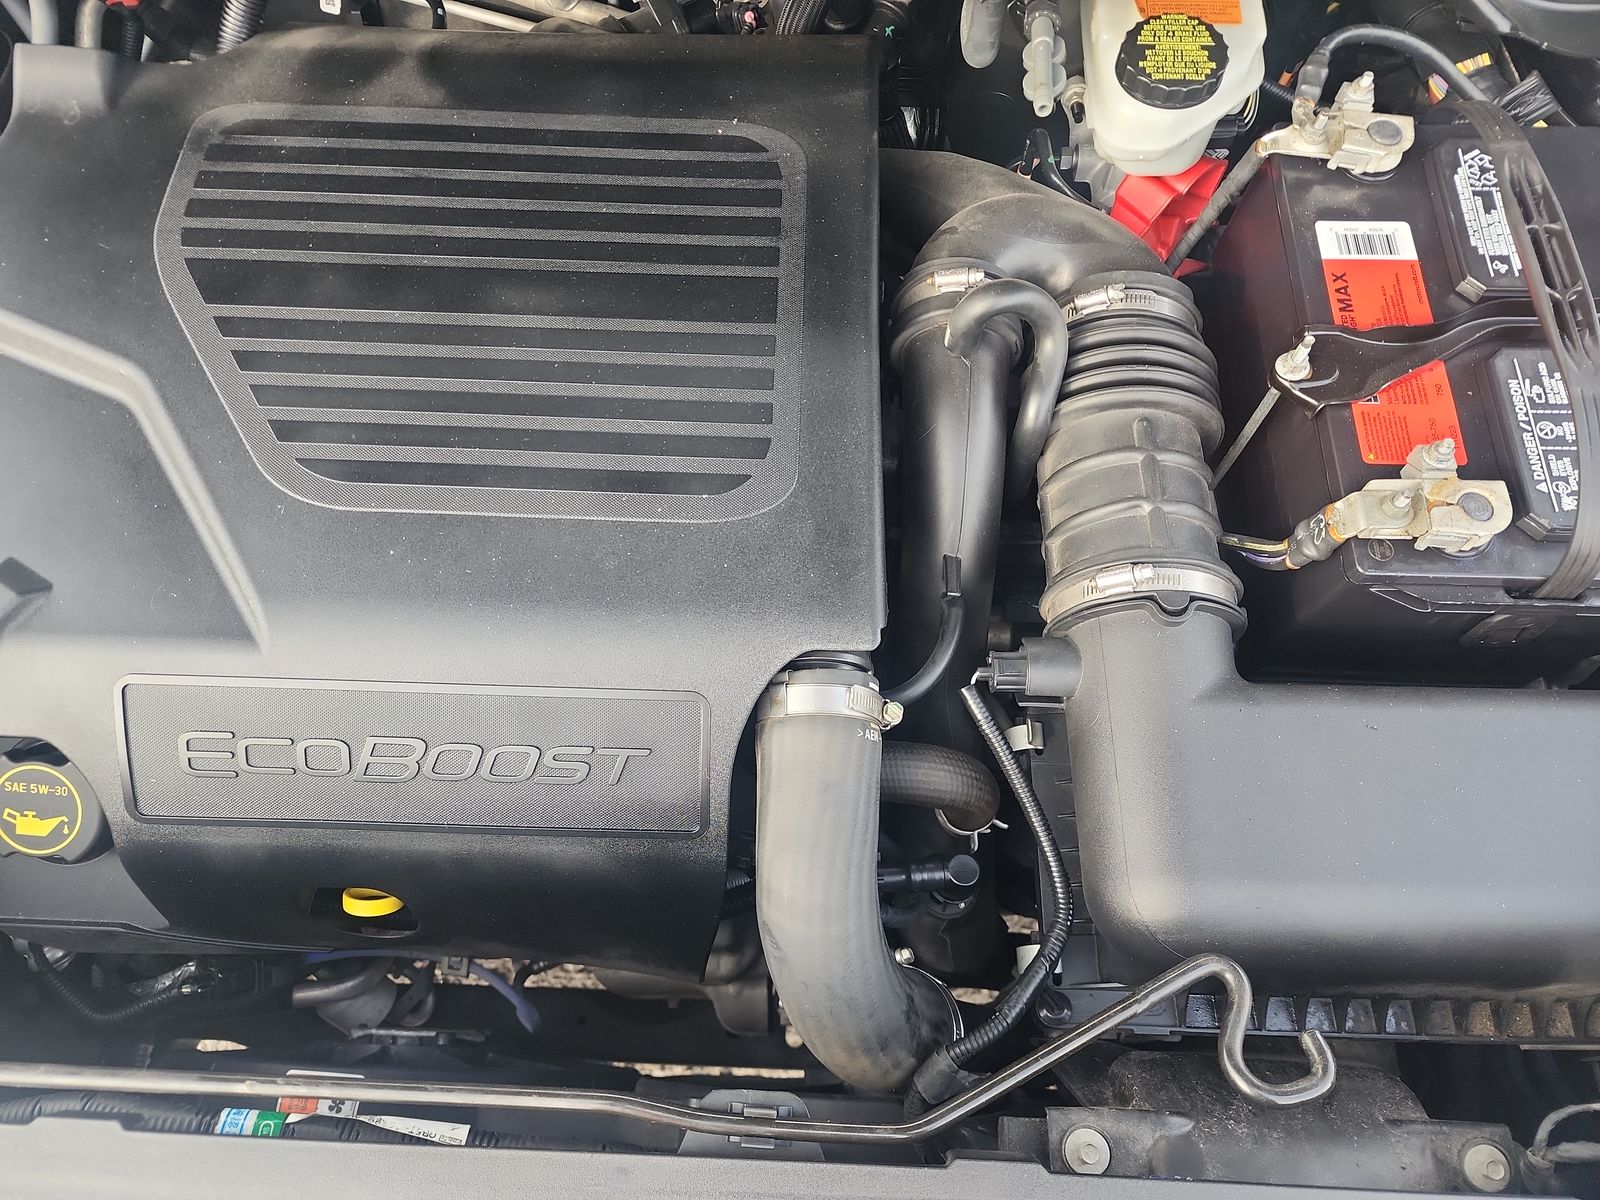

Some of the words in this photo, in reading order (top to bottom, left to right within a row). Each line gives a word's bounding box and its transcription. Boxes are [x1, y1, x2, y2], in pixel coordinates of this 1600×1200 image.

[1332, 272, 1354, 313] MAX
[1435, 384, 1444, 397] 750
[1508, 380, 1529, 420] POISON
[1556, 426, 1565, 436] NO
[1522, 432, 1545, 480] DANGER
[1547, 454, 1561, 477] SHIELD
[1557, 460, 1567, 476] EYES
[1563, 457, 1579, 490] EXPLOSIVE
[4, 782, 27, 793] SAE
[30, 784, 68, 796] 5W-30
